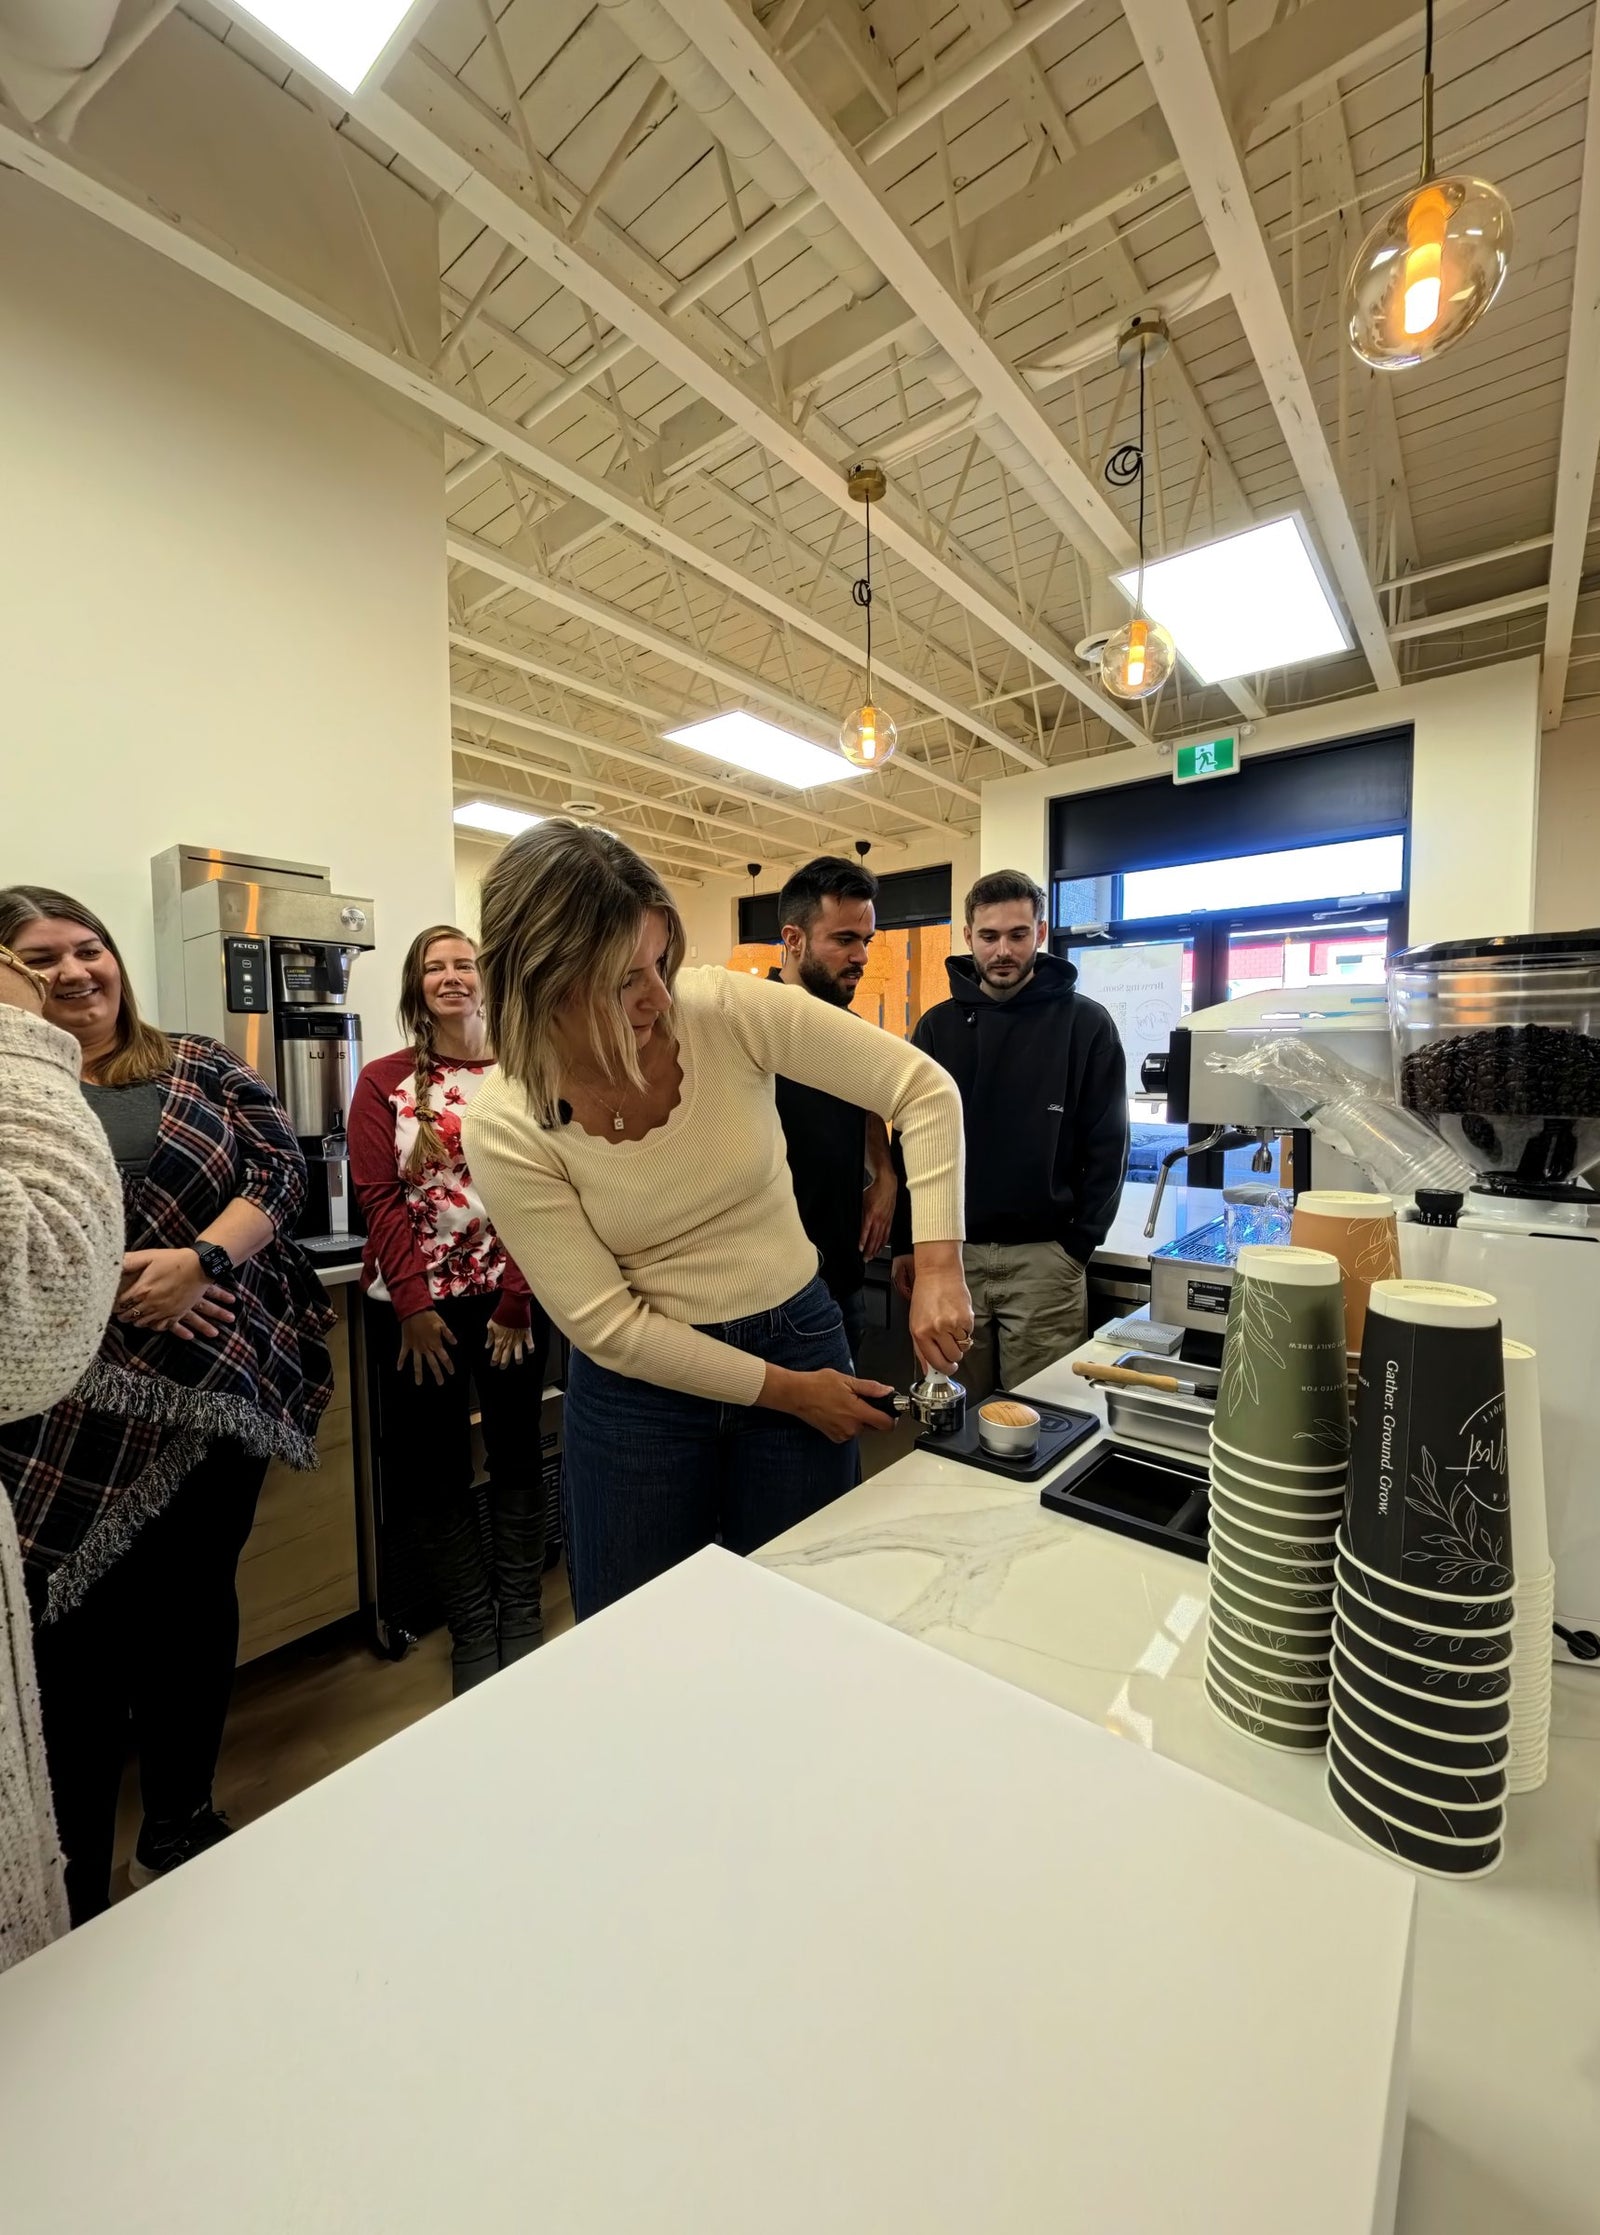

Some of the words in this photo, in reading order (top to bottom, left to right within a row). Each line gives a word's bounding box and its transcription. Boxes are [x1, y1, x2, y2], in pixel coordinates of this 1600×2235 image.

[1288, 1342, 1313, 1350] BREW
[1316, 1342, 1336, 1350] DAILY
[1301, 1384, 1318, 1392] FOR
[1384, 1360, 1399, 1410] Gather.
[1380, 1415, 1396, 1471] Ground.
[1378, 1475, 1393, 1516] Grow.
